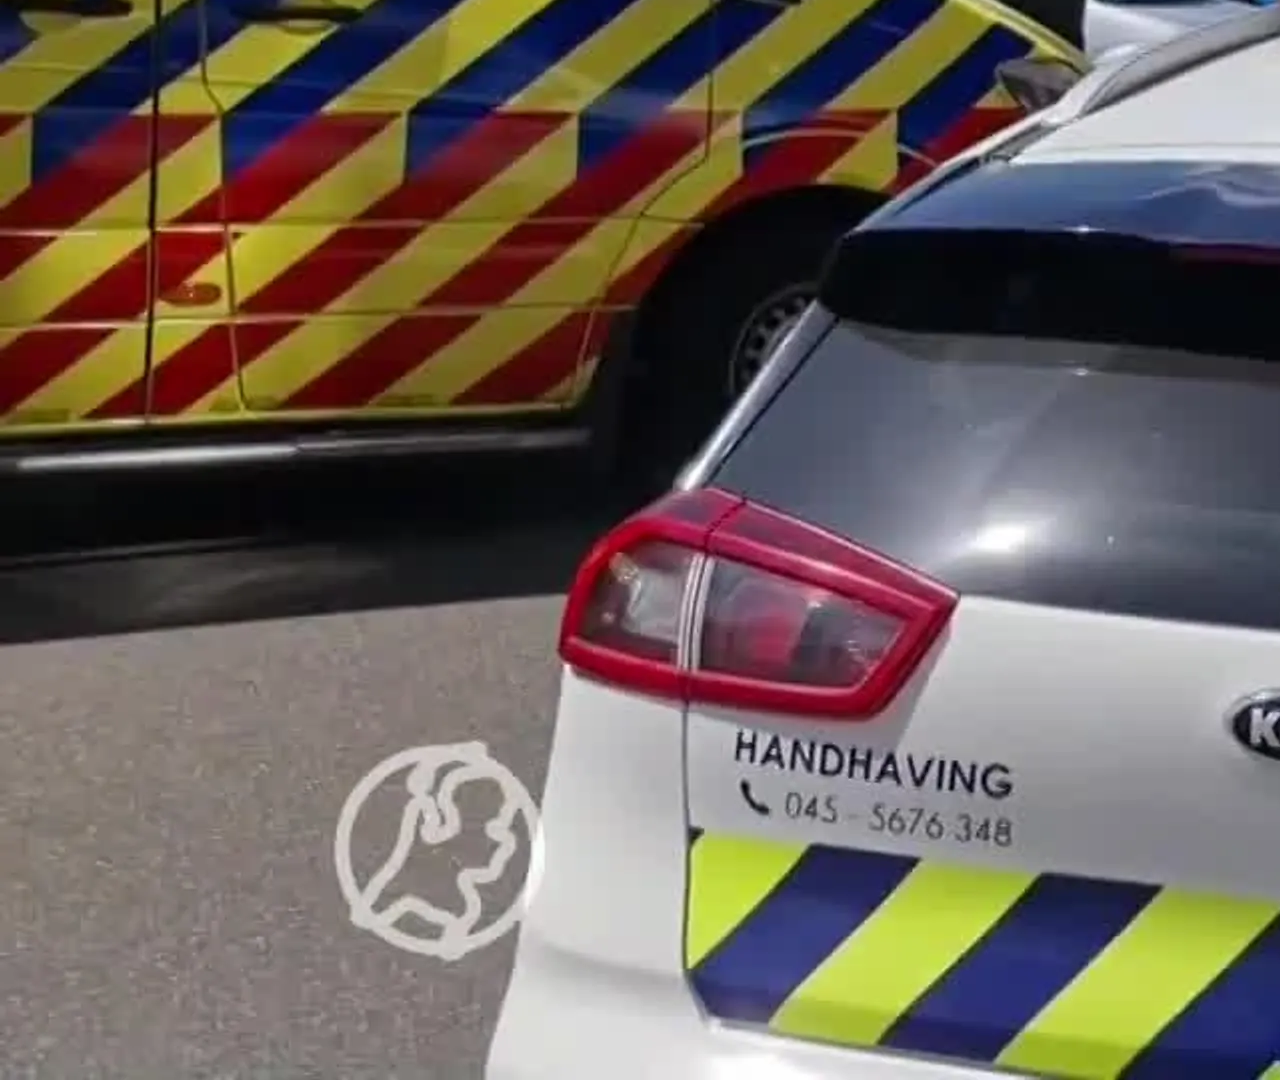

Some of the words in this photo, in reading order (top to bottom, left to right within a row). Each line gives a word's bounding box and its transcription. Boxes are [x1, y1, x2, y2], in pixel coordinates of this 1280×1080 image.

[734, 730, 1014, 799] HANDHAVING
[785, 791, 839, 824] 045
[868, 802, 944, 840] 5676
[954, 813, 1013, 847] 348
